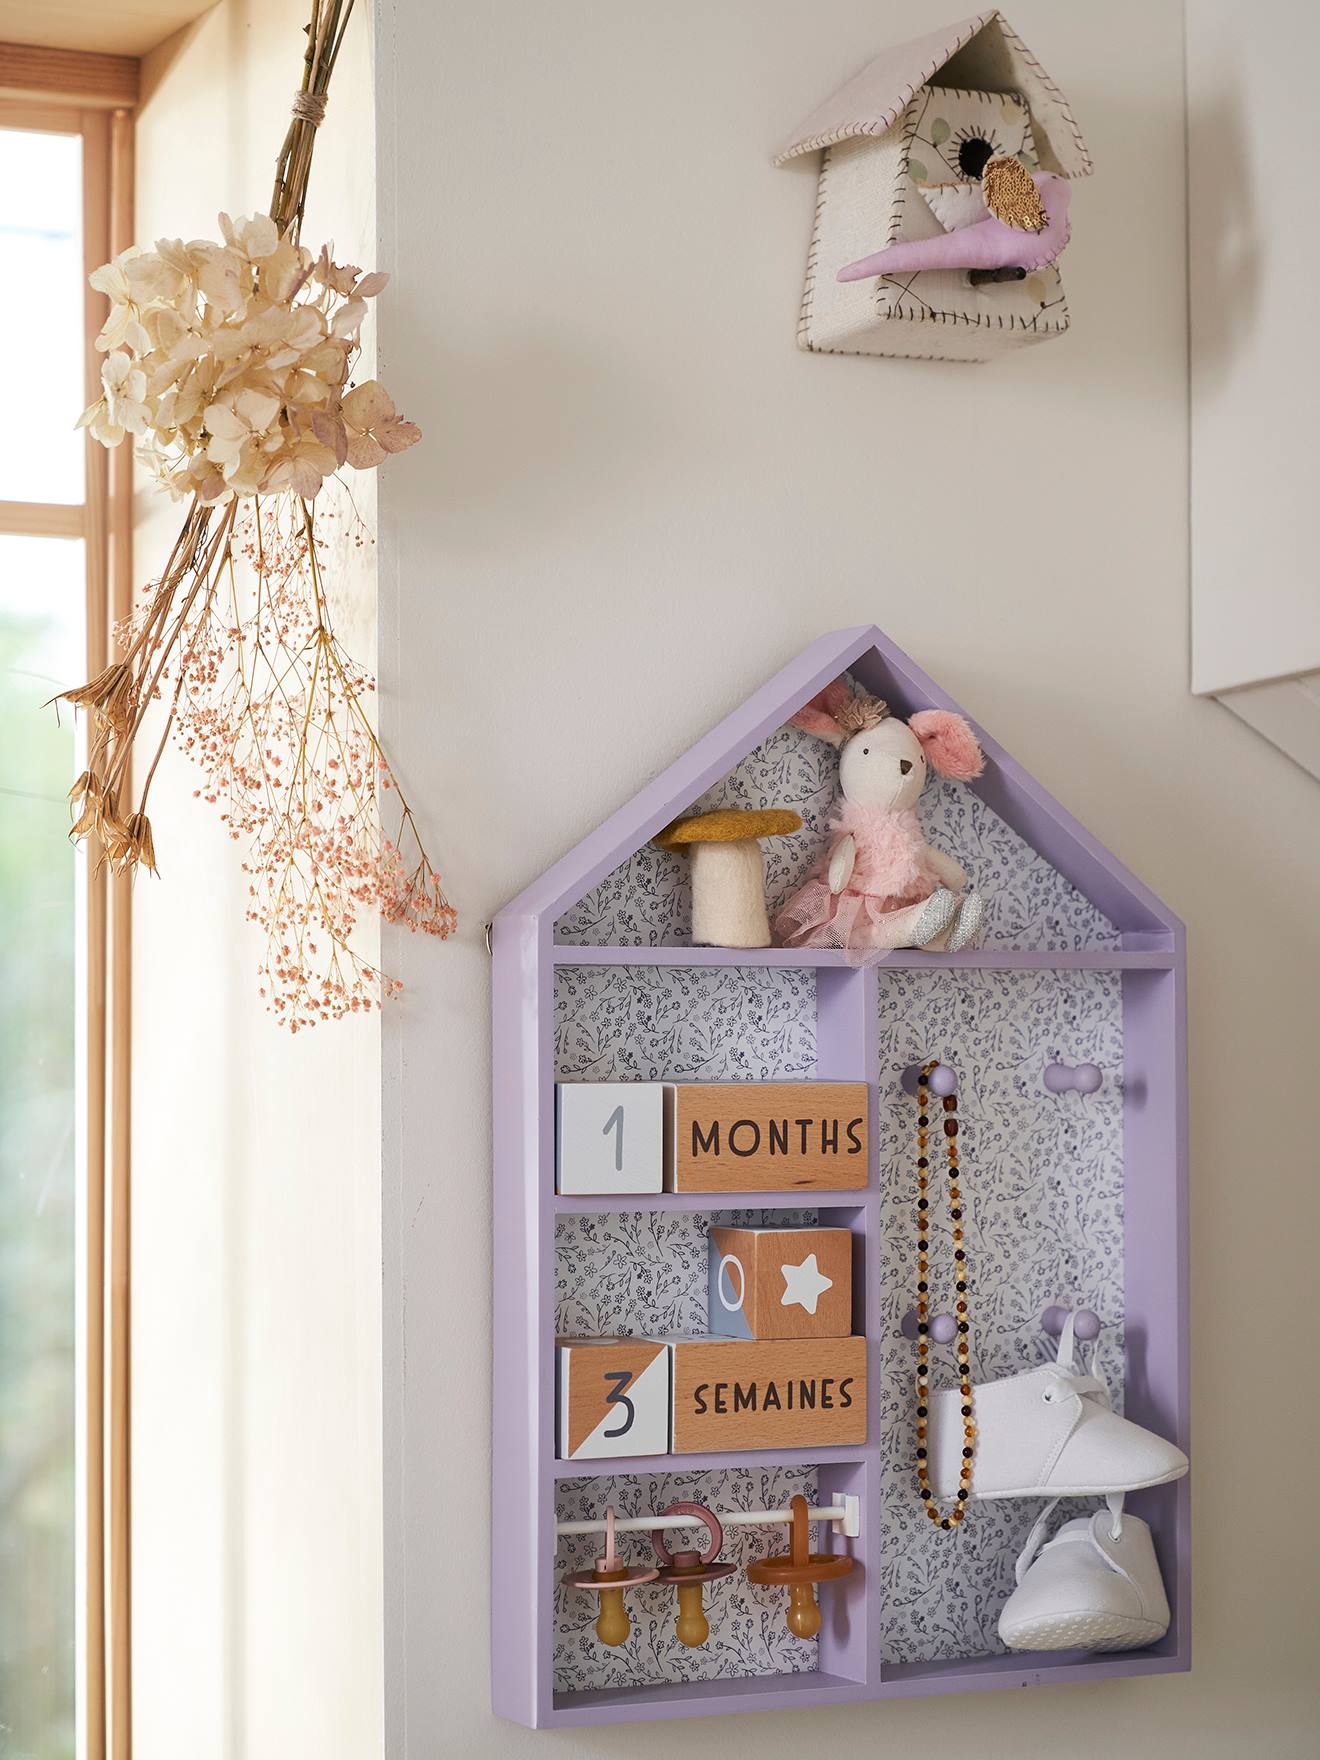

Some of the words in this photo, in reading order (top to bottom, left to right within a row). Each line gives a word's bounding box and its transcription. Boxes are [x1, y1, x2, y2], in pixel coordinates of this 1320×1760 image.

[602, 1105, 624, 1171] 1
[692, 1118, 864, 1157] MONTHS
[604, 1371, 635, 1438] 3
[694, 1377, 854, 1414] SEMAINES
